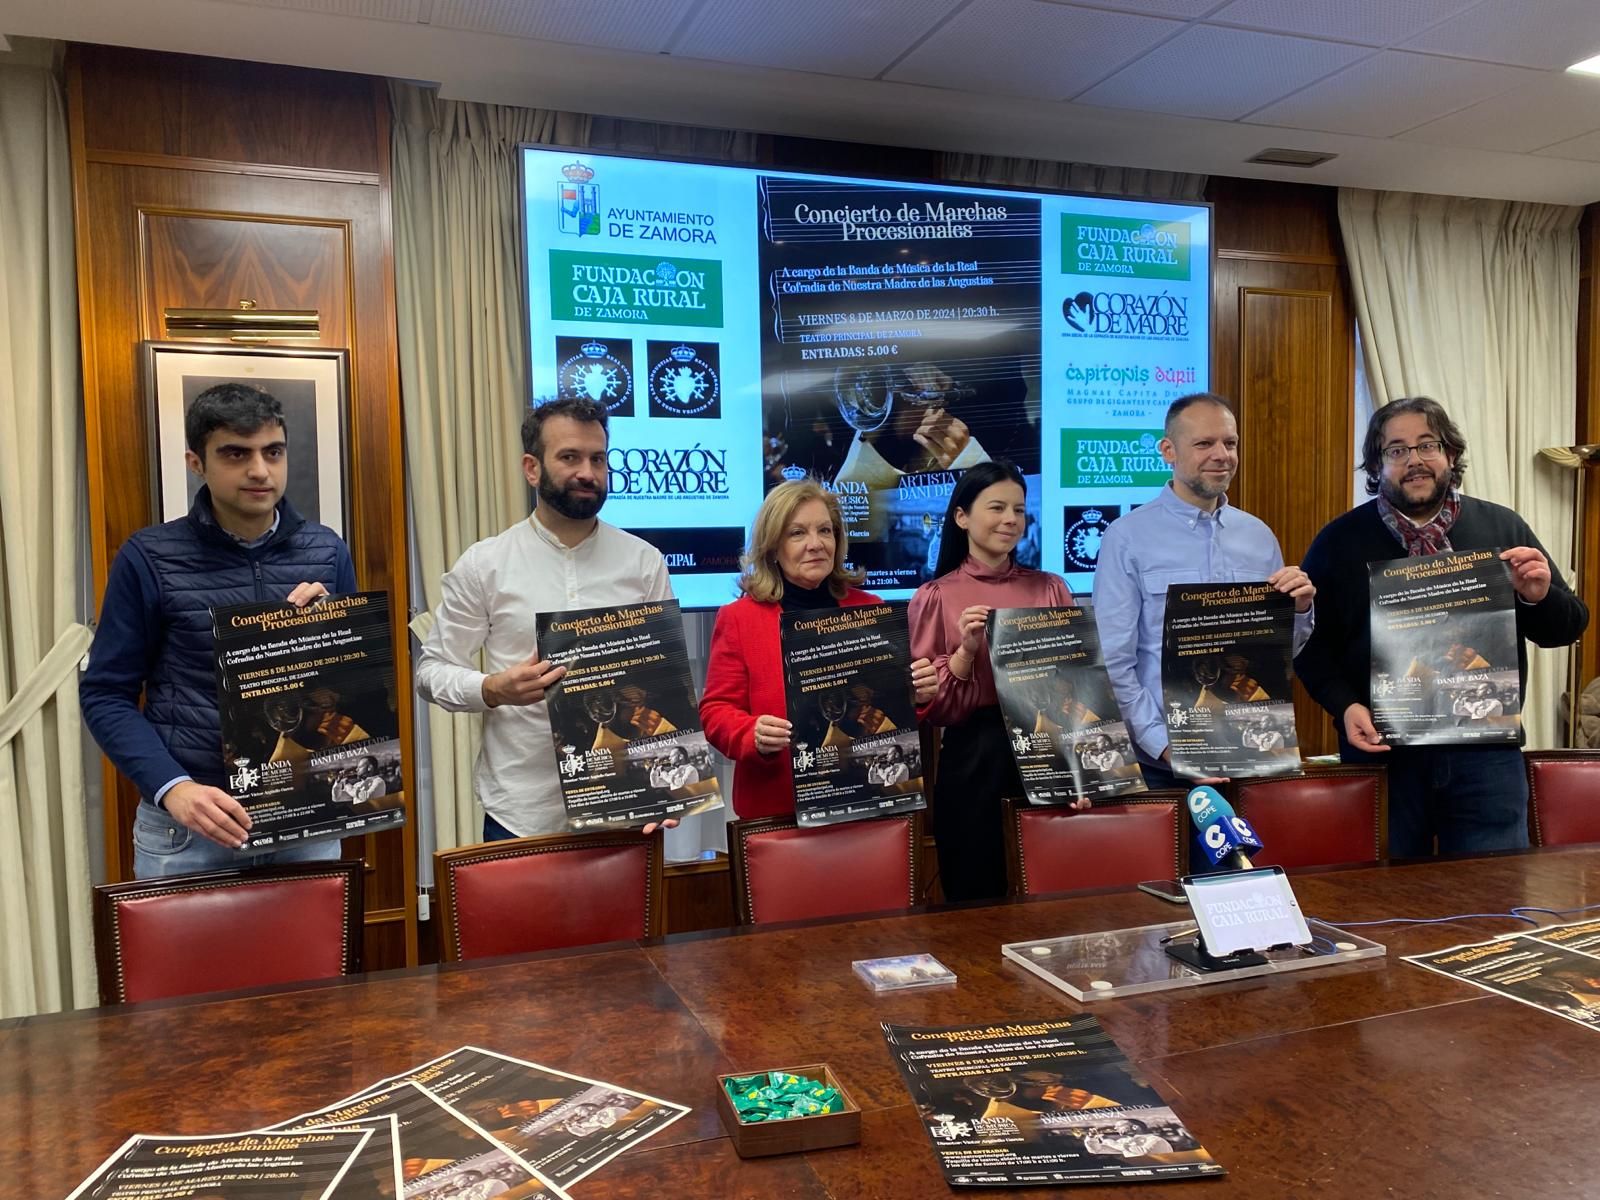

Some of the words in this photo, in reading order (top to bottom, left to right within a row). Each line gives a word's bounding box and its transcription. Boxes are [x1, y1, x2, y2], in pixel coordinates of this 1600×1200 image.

[608, 208, 714, 226] AYUNTAMIENTO
[795, 204, 891, 225] Concierto
[897, 203, 920, 222] de
[925, 202, 1007, 222] Marchas
[609, 223, 633, 238] DE
[639, 225, 716, 244] ZAMORA
[843, 220, 972, 241] Procesionales
[1078, 243, 1118, 262] CAJA
[1123, 246, 1178, 264] RURAL
[782, 267, 790, 278] A
[792, 268, 821, 280] cargo
[823, 267, 835, 276] de
[837, 266, 846, 276] la
[850, 264, 879, 275] Banda
[882, 264, 894, 274] de
[896, 263, 929, 274] Música
[932, 263, 944, 273] de
[946, 262, 954, 272] la
[958, 261, 978, 271] Real
[1079, 263, 1091, 271] DE
[1095, 263, 1134, 274] ZAMORA
[828, 282, 840, 292] de
[843, 280, 881, 291] Nuestra
[885, 278, 916, 289] Madre
[918, 278, 930, 288] de
[932, 277, 945, 287] las
[948, 276, 993, 288] Angustias
[573, 284, 627, 305] CAJA
[633, 288, 705, 309] RURAL
[1093, 290, 1188, 317] CORAZÓN
[574, 307, 591, 317] DE
[597, 308, 648, 320] ZAMORA
[798, 313, 847, 326] VIERNES
[850, 313, 856, 323] 8
[858, 312, 873, 323] DE
[876, 310, 914, 321] MARZO
[916, 309, 931, 320] DE
[933, 308, 955, 319] 2024
[962, 307, 987, 318] 20:30
[989, 306, 999, 317] h.
[1094, 313, 1122, 334] DE
[1126, 314, 1189, 336] MADRE
[800, 332, 831, 343] TEATRO
[834, 331, 873, 342] PRINCIPAL
[877, 330, 890, 339] DE
[890, 329, 922, 338] ZAMORA
[802, 347, 865, 360] ENTRADAS:
[867, 346, 889, 356] 5.00
[891, 345, 898, 355] €
[607, 442, 727, 472] CORAZÓN
[1077, 457, 1117, 472] CAJA
[608, 471, 642, 493] DE
[644, 471, 729, 493] MADRE
[822, 482, 869, 494] BANDA
[899, 472, 956, 488] ARTISTA
[1094, 475, 1133, 483] ZAMORA
[900, 486, 931, 500] DANI
[936, 484, 952, 497] DE
[1384, 563, 1430, 578] Concierto
[1432, 559, 1444, 568] de
[1447, 551, 1493, 566] Marchas
[1406, 563, 1473, 581] Procesionales
[1181, 591, 1227, 602] Concierto
[1229, 588, 1240, 596] de
[1202, 594, 1265, 607] Procesionales
[231, 607, 293, 628] Concierto
[314, 596, 368, 613] Marchas
[262, 609, 347, 632] Procesionales
[551, 617, 601, 633] Concierto
[603, 613, 616, 622] de
[618, 604, 663, 620] Marchas
[794, 615, 839, 631] Concierto
[841, 612, 852, 621] de
[853, 606, 892, 619] Marchas
[999, 615, 1037, 627] Concierto
[1039, 612, 1048, 620] de
[1049, 609, 1082, 621] Marchas
[576, 616, 646, 637] Procesionales
[816, 617, 877, 635] Procesionales
[1018, 619, 1070, 632] Procesionales
[238, 669, 269, 681] VIERNES
[287, 662, 313, 673] MARZO
[325, 657, 339, 665] 2024
[239, 681, 260, 690] TEATRO
[261, 676, 288, 686] PRINCIPAL
[241, 686, 282, 699] ENTRADAS:
[284, 683, 298, 691] 5.00
[628, 744, 646, 755] DANI
[648, 742, 658, 751] DE
[659, 738, 679, 748] BAZA
[852, 743, 869, 752] DANI
[880, 737, 896, 746] BAZA
[261, 760, 292, 770] BANDA
[310, 756, 332, 767] DANI
[334, 753, 345, 762] DE
[347, 747, 369, 758] BAZA
[1198, 806, 1216, 822] COPE
[1243, 836, 1258, 845] COPE
[1216, 842, 1232, 858] COPE
[1211, 913, 1244, 927] CAJA
[1247, 908, 1288, 923] RURAL
[911, 1028, 983, 1040] Concierto
[1004, 1020, 1071, 1032] Marchas
[948, 1029, 1048, 1043] Procesionales
[933, 1070, 985, 1079] ENTRADAS:
[155, 1140, 232, 1155] Concierto
[239, 1138, 255, 1147] de
[258, 1133, 335, 1145] Marchas
[186, 1142, 300, 1158] Procesionales
